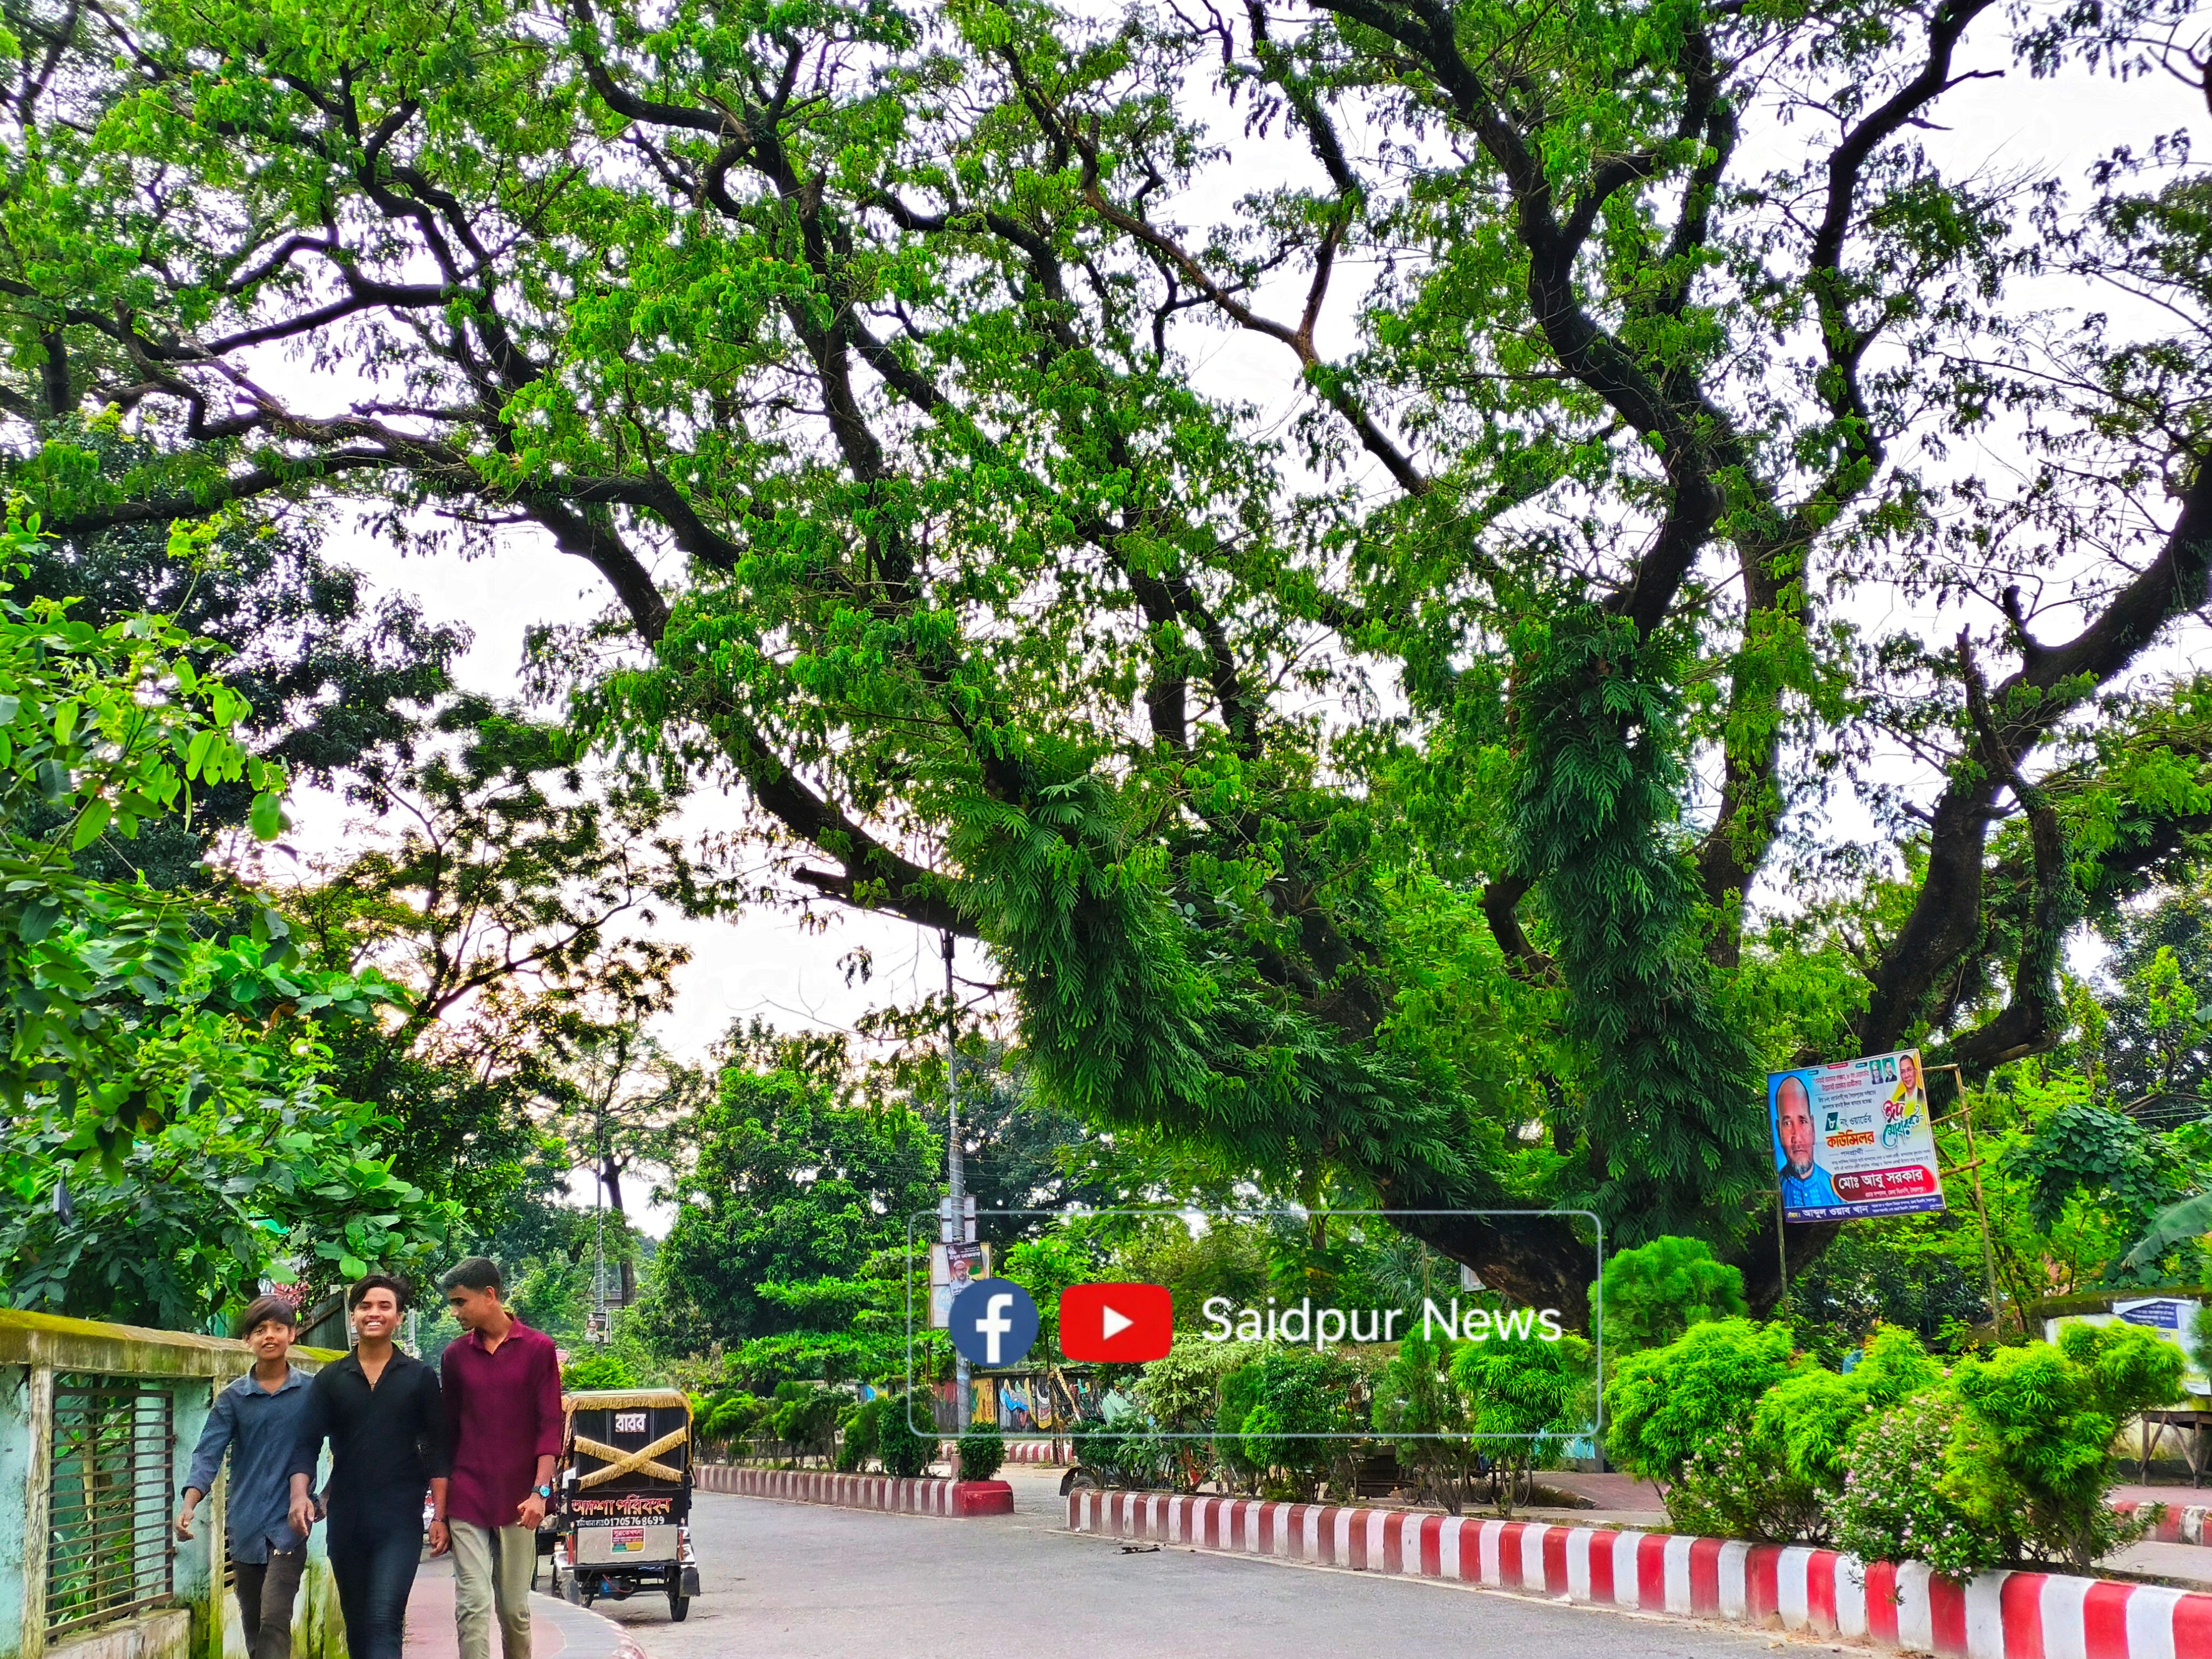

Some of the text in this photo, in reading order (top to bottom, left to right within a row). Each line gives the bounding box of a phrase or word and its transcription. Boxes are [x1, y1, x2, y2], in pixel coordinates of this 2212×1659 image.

[1828, 1112, 1873, 1129] ৮ নং ওয়ার্ডের
[1883, 1100, 1905, 1123] ঈদ
[1883, 1105, 1924, 1148] মোবারক
[1826, 1129, 1875, 1148] কাউন্সিলর
[1838, 1168, 1924, 1190] মোঃ আবু সরকার
[1852, 1205, 1869, 1214] খান
[616, 1494, 673, 1515] পরিবহন
[604, 1515, 665, 1526] 01705768699
